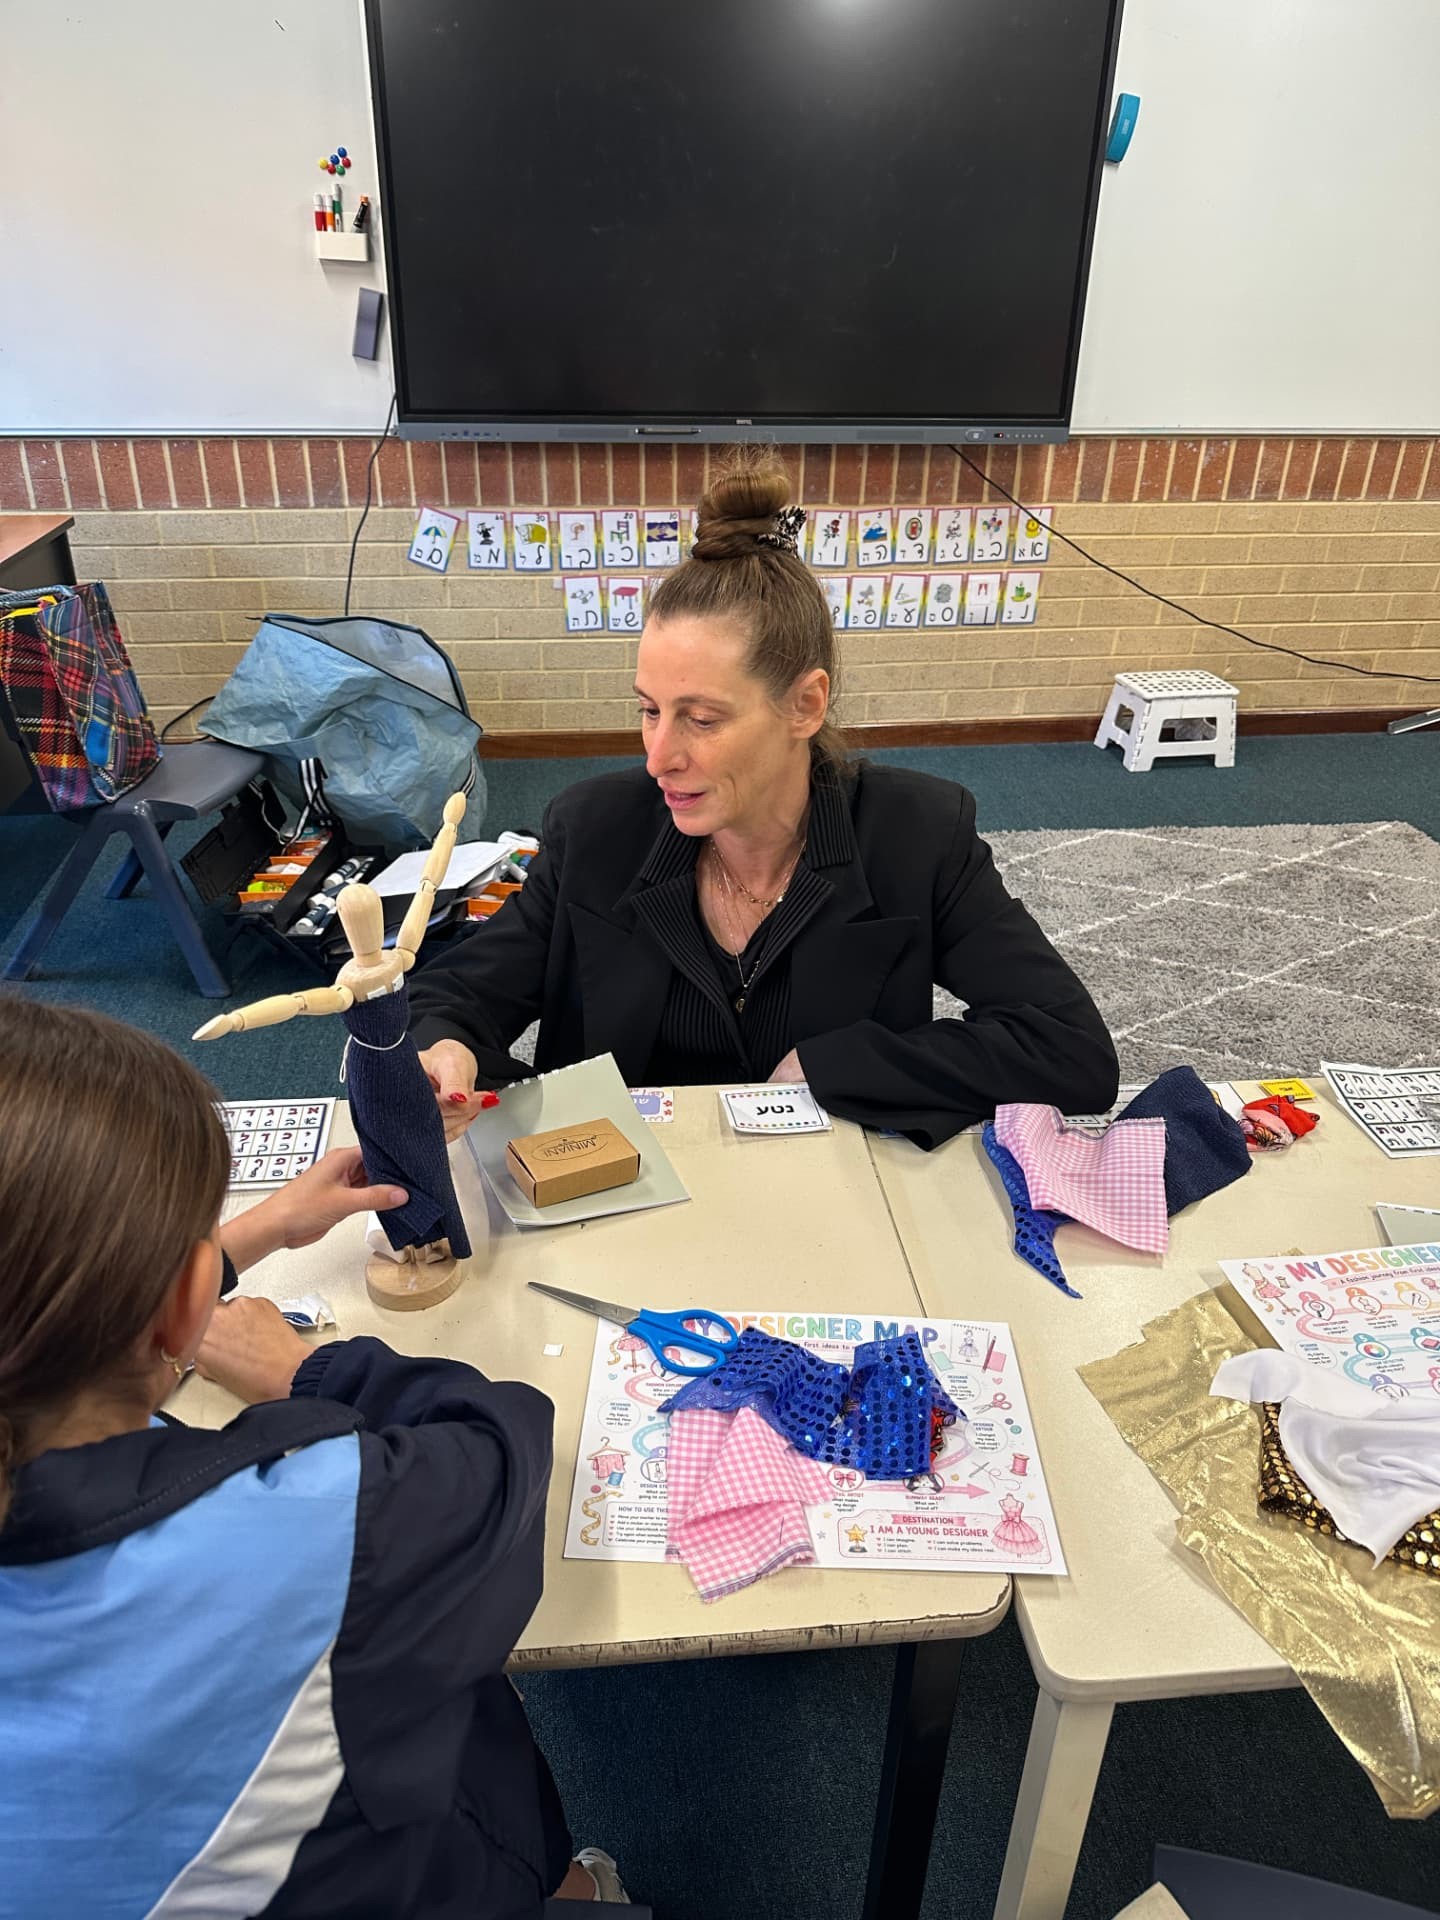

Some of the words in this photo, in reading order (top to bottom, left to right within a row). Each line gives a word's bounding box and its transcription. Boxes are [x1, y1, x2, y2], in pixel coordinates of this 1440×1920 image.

[756, 1104, 795, 1116] נטע
[543, 1139, 597, 1158] MINIANI
[1285, 1261, 1327, 1282] MY
[902, 1516, 954, 1525] DESTINATION
[870, 1525, 875, 1533] I
[878, 1526, 893, 1534] AM
[897, 1526, 904, 1535] A
[906, 1527, 939, 1536] YOUNG
[943, 1528, 989, 1538] DESIGNER
